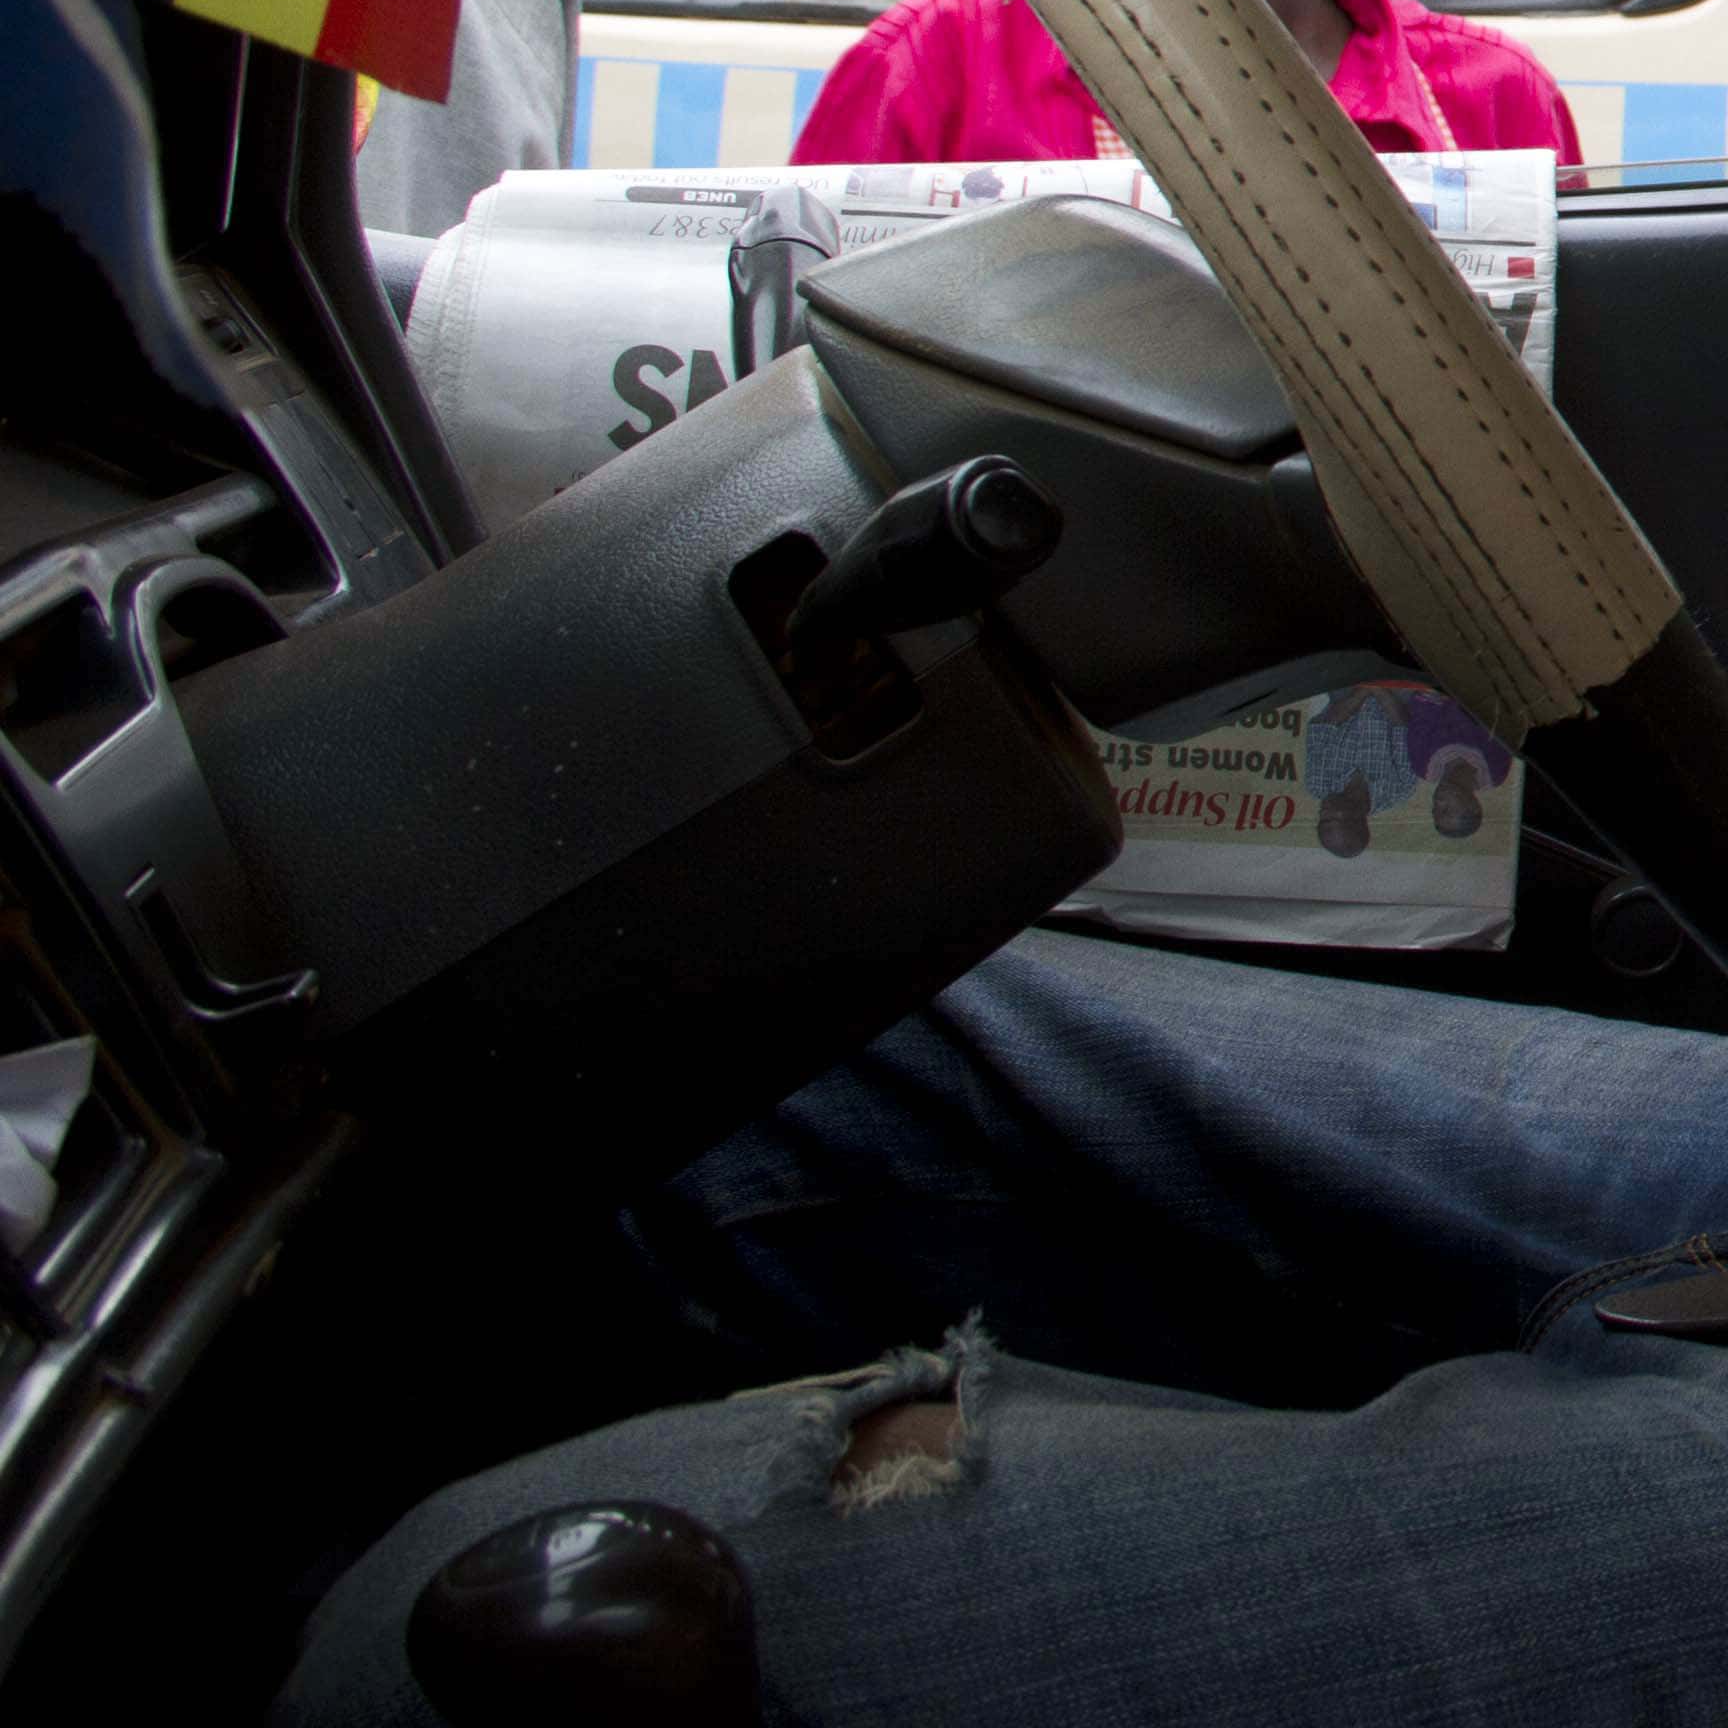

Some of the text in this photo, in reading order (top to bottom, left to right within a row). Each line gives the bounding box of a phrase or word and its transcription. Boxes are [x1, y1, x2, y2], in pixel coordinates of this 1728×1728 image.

[682, 190, 736, 204] UNEB
[1168, 746, 1297, 781] Women
[1236, 792, 1296, 831] Oil
